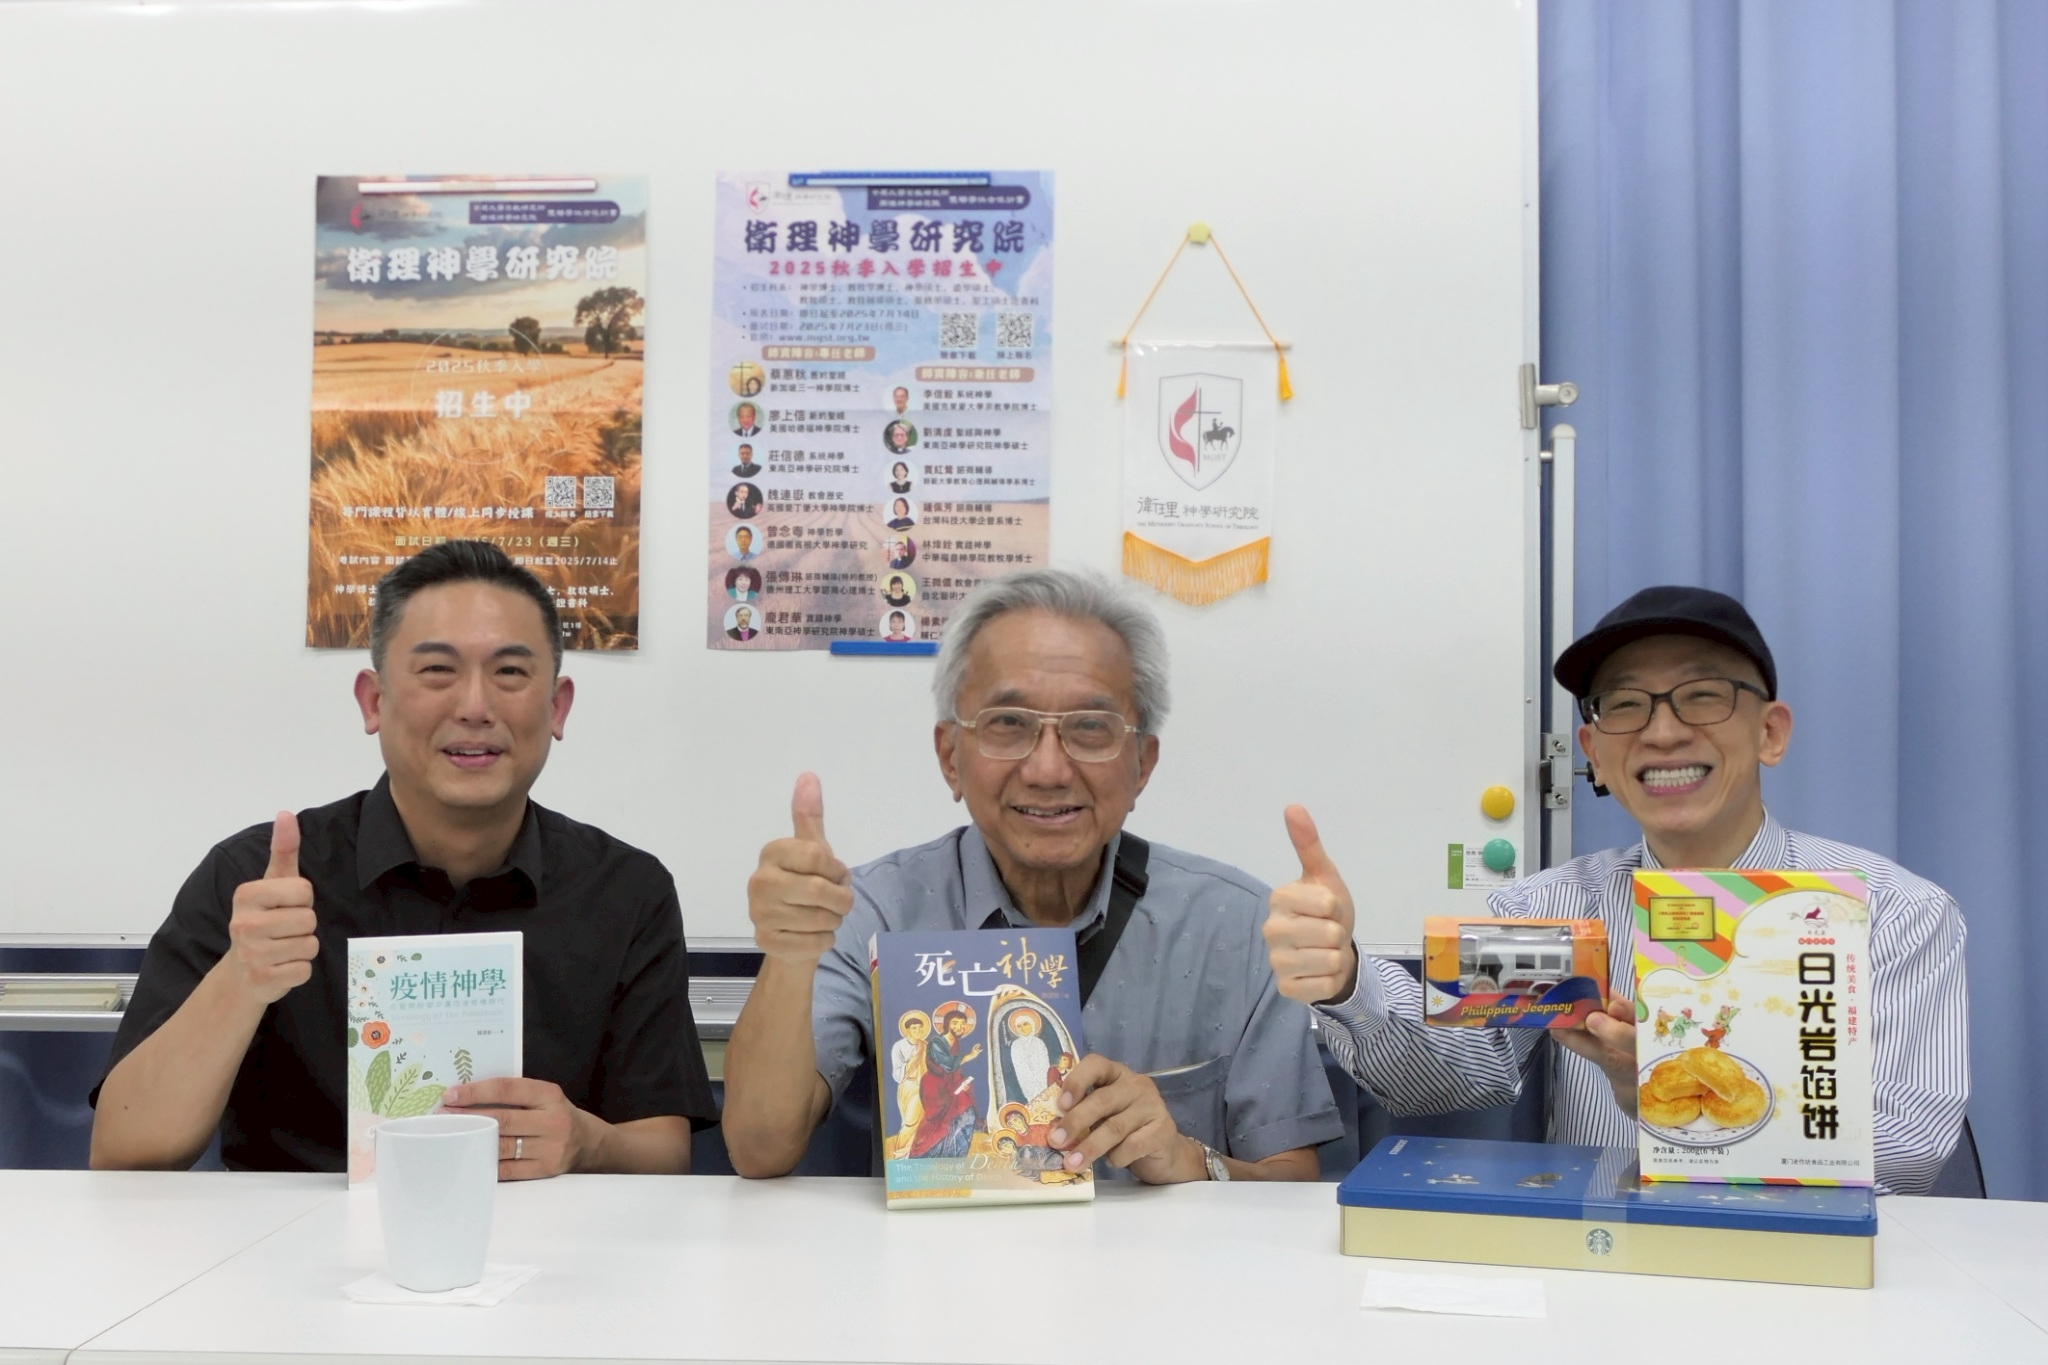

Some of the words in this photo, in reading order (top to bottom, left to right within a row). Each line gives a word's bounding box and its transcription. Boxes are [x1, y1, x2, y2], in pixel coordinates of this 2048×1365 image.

[745, 219, 1025, 254] 衛理神學研究院
[346, 245, 619, 284] 衛理神學研究院
[769, 259, 1004, 278] 2025秋季入學招生中
[778, 334, 870, 343] www.mgst.org.tw
[425, 359, 542, 374] 2025秋季入學
[957, 390, 993, 399] 系統神學
[436, 390, 532, 418] 招生中
[768, 409, 806, 422] 廖上信
[923, 441, 1029, 450] 東南亞神學研究院神學碩士
[768, 450, 805, 462] 莊信德
[808, 451, 845, 460] 系統神學
[769, 465, 860, 474] 東南亞神學研究院博士
[767, 503, 875, 513] 英國愛丁堡大學神學院博士
[1182, 504, 1259, 520] 神學研究院
[923, 516, 1023, 526] 台灣科技大學企管系博士
[922, 553, 1033, 564] 中華福音神學院教牧學博士
[765, 626, 876, 636] 東南亞神學研究院神學碩士
[389, 968, 507, 1001] 疫情神學
[1460, 1003, 1519, 1018] Philippine
[1522, 1002, 1573, 1016] Jeepney
[1797, 952, 1839, 1140] 日光岩馅饼
[896, 1163, 912, 1172] The
[914, 1161, 954, 1172] Theology
[956, 1161, 966, 1170] of
[895, 1174, 913, 1183] and
[931, 1173, 963, 1184] History
[965, 1172, 975, 1181] of
